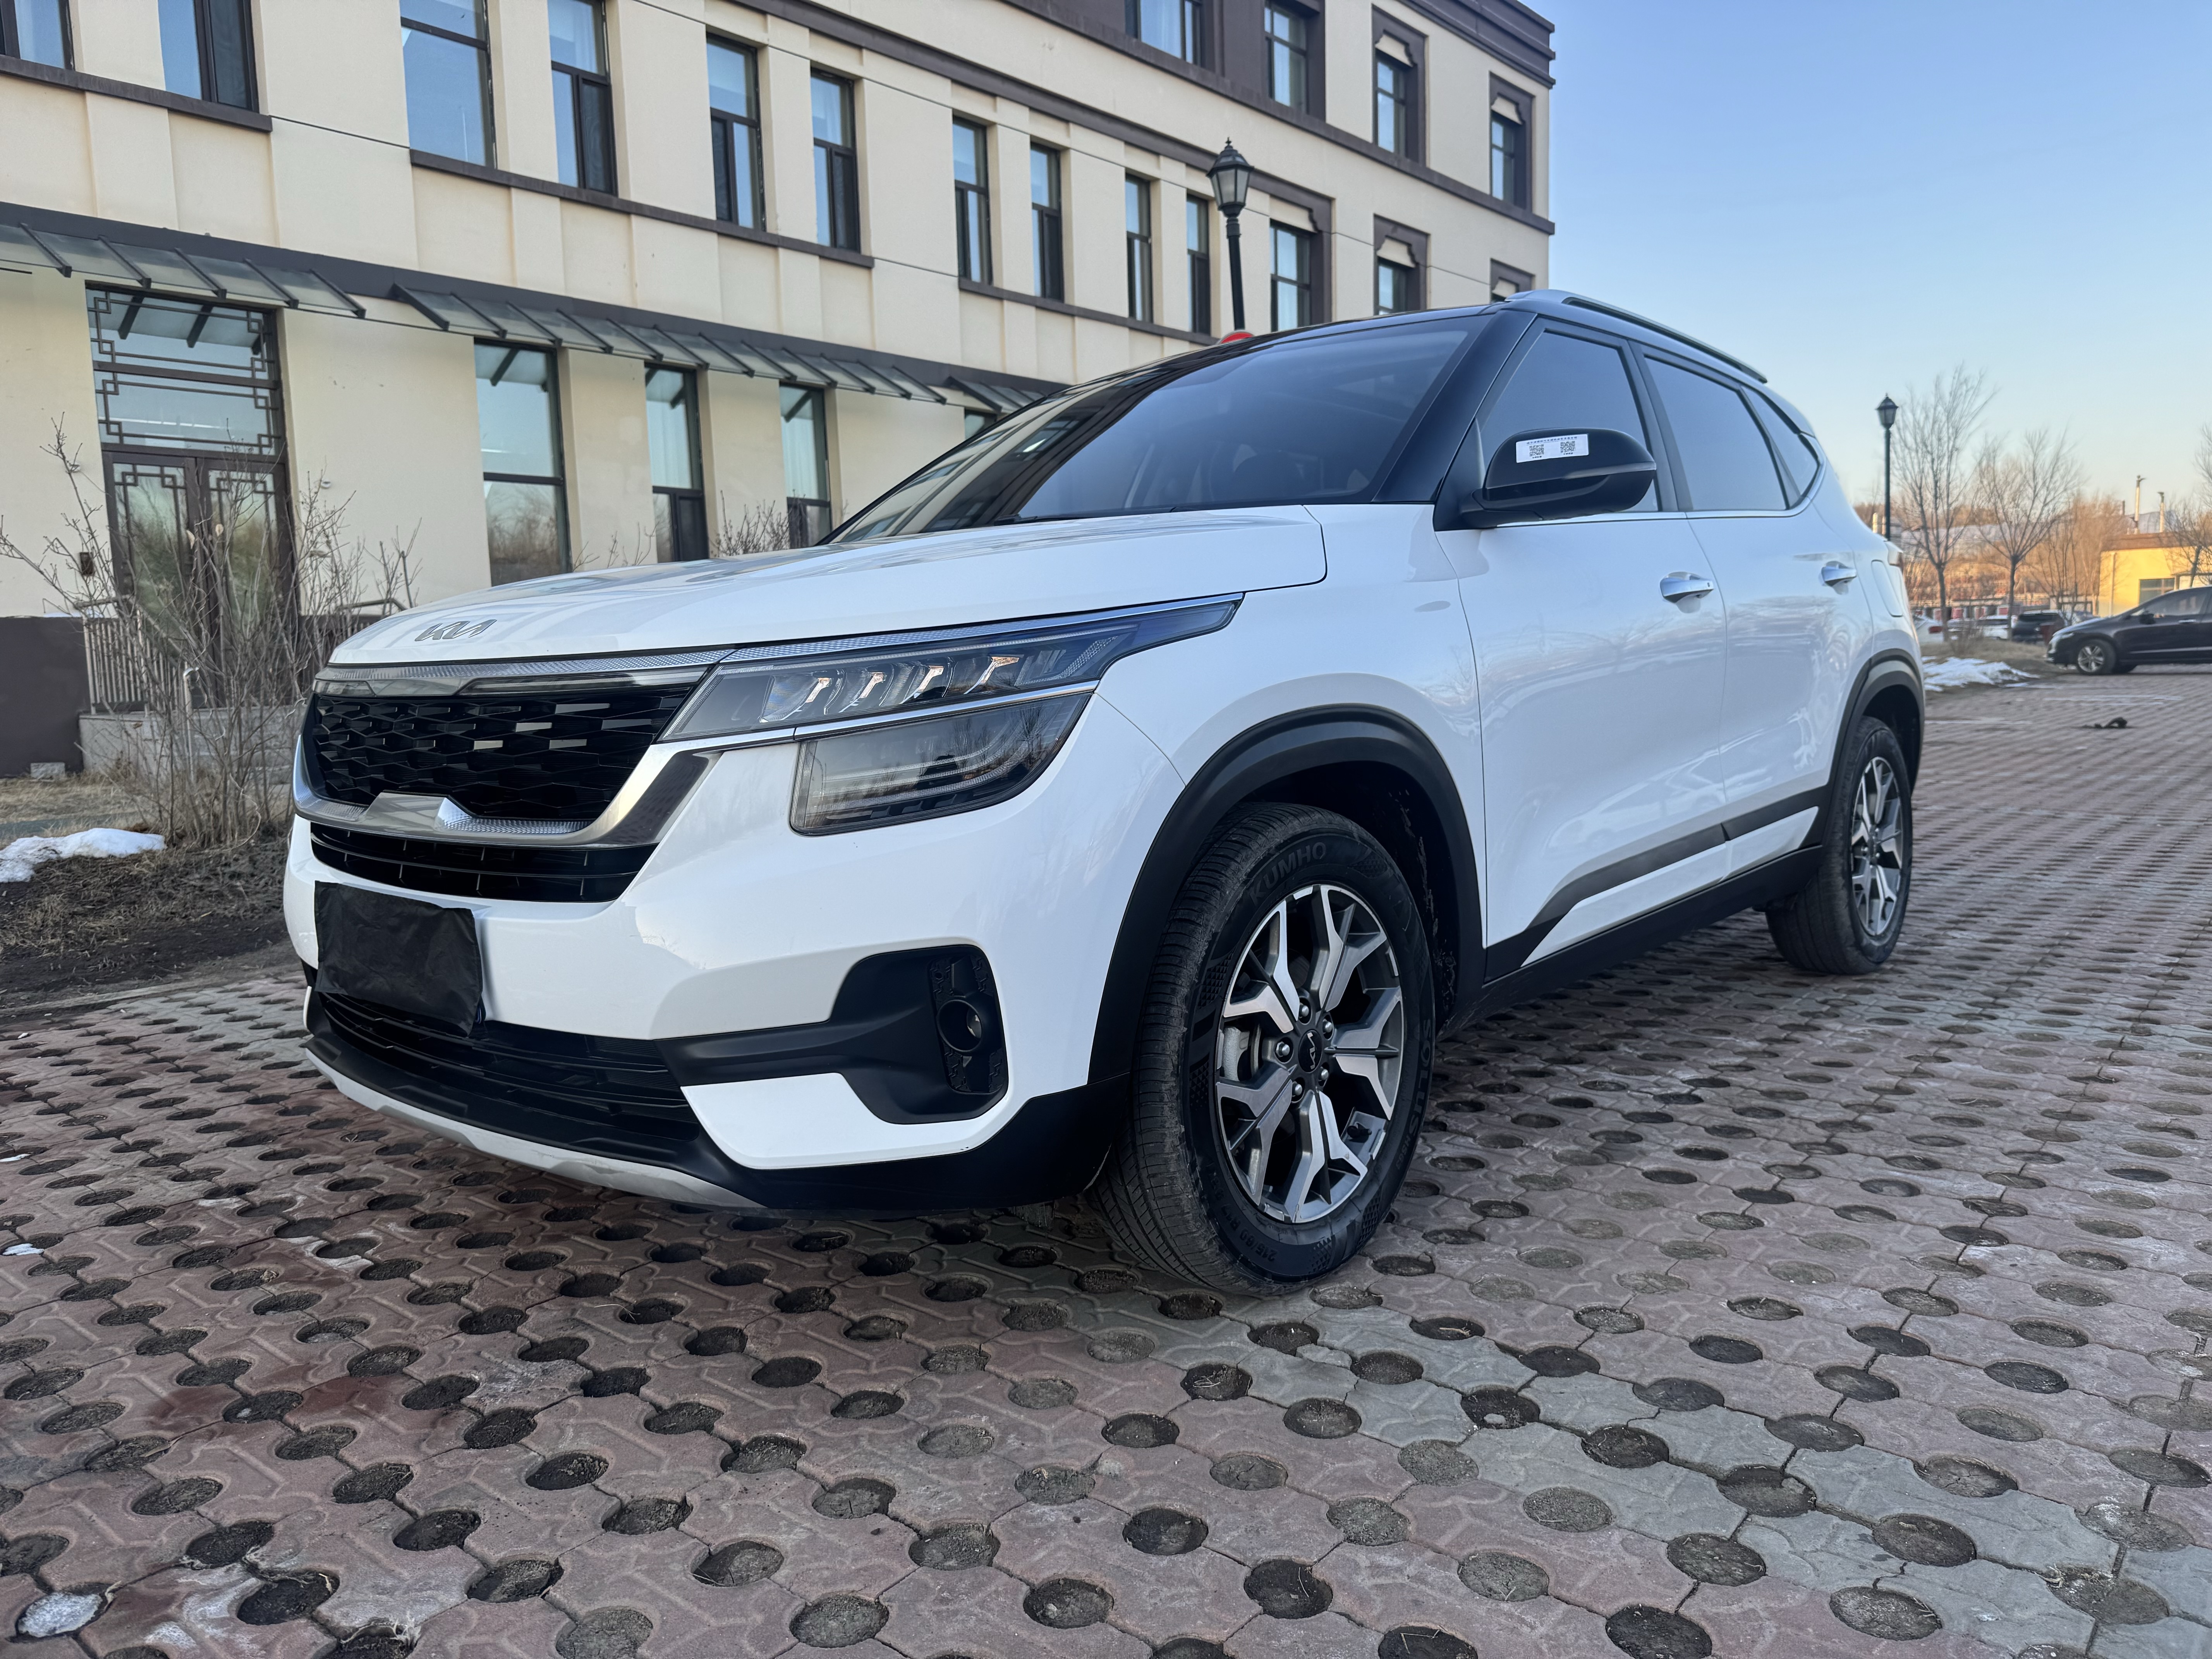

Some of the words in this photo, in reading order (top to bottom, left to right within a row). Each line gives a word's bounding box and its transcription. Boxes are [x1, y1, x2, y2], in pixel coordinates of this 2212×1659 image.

[414, 619, 497, 642] KIA
[1249, 842, 1326, 906] KUMHO
[1409, 1018, 1431, 1137] SOLUS
[1239, 1228, 1278, 1262] 215/60
